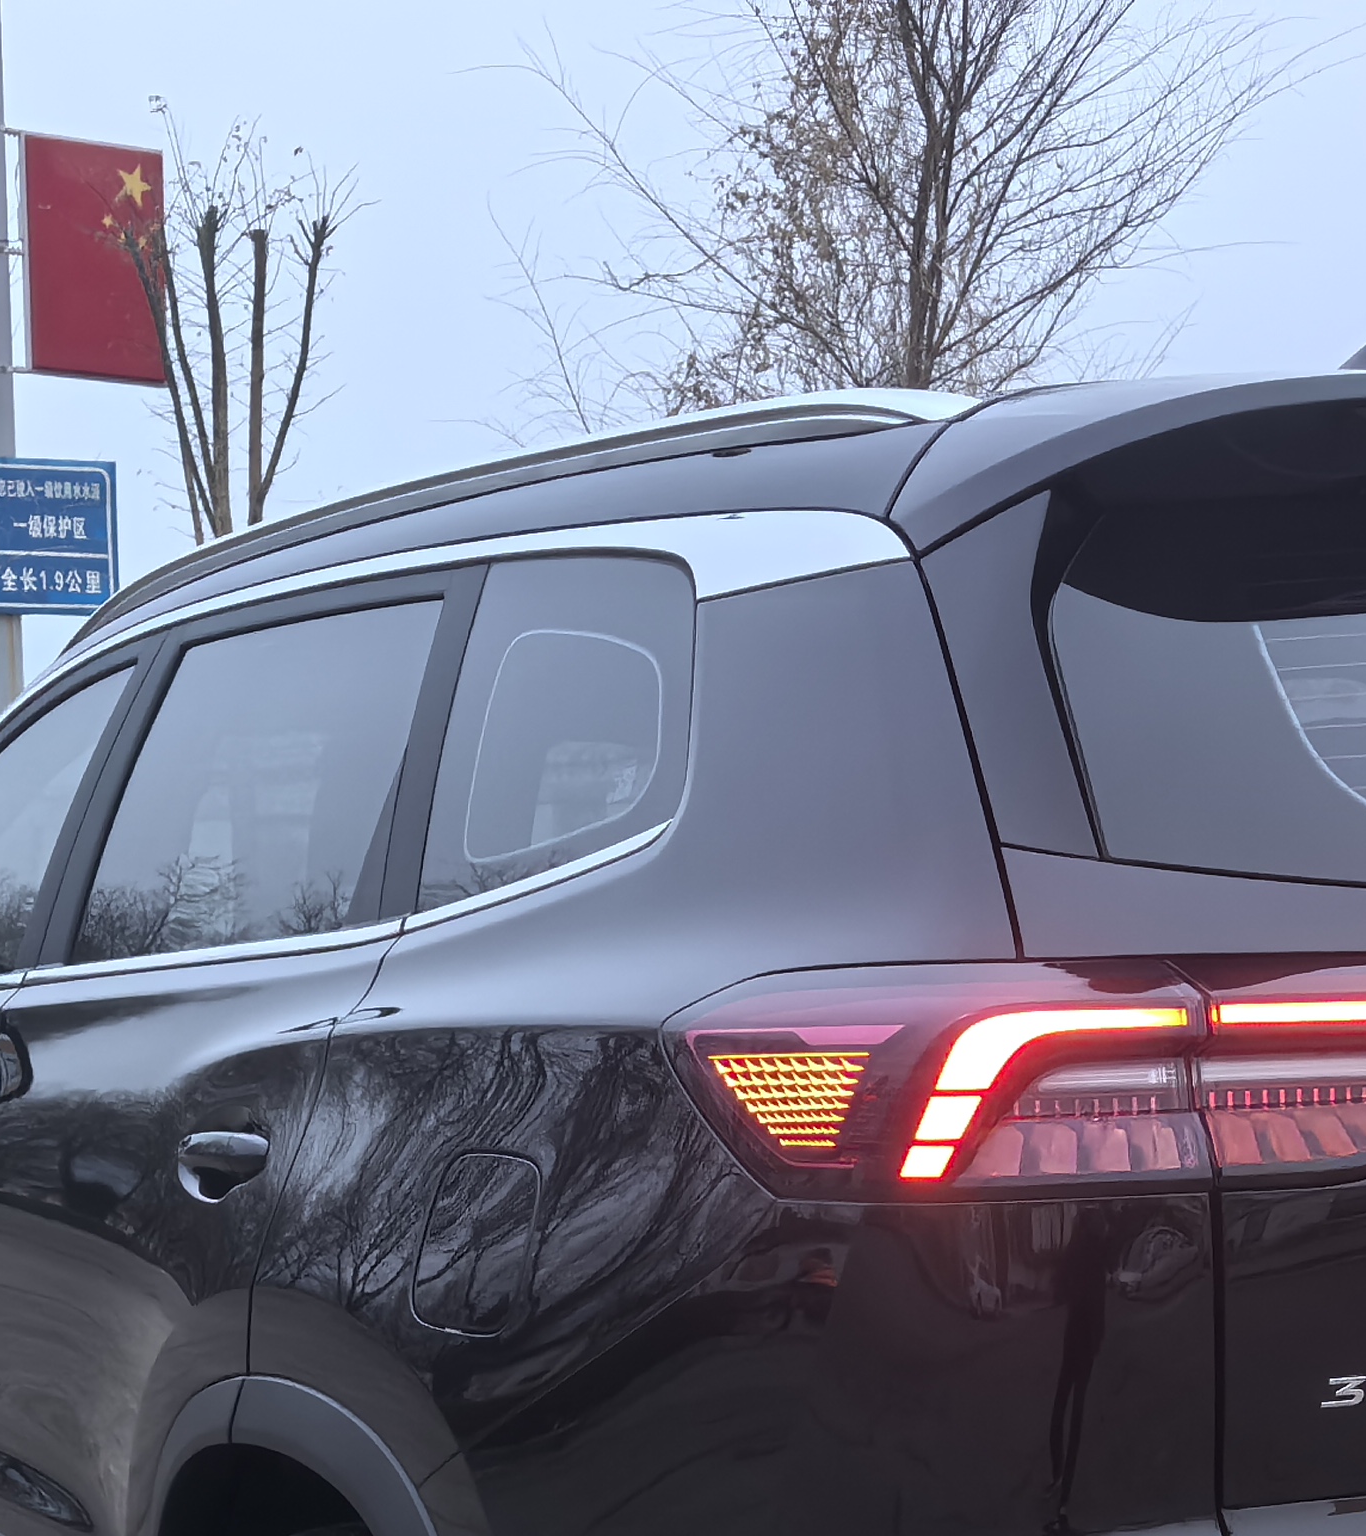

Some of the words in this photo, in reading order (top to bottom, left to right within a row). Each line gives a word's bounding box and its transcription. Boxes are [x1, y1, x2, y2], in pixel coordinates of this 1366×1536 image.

[13, 515, 87, 539] 一级保护区
[1, 567, 102, 593] 全长1.9公里
